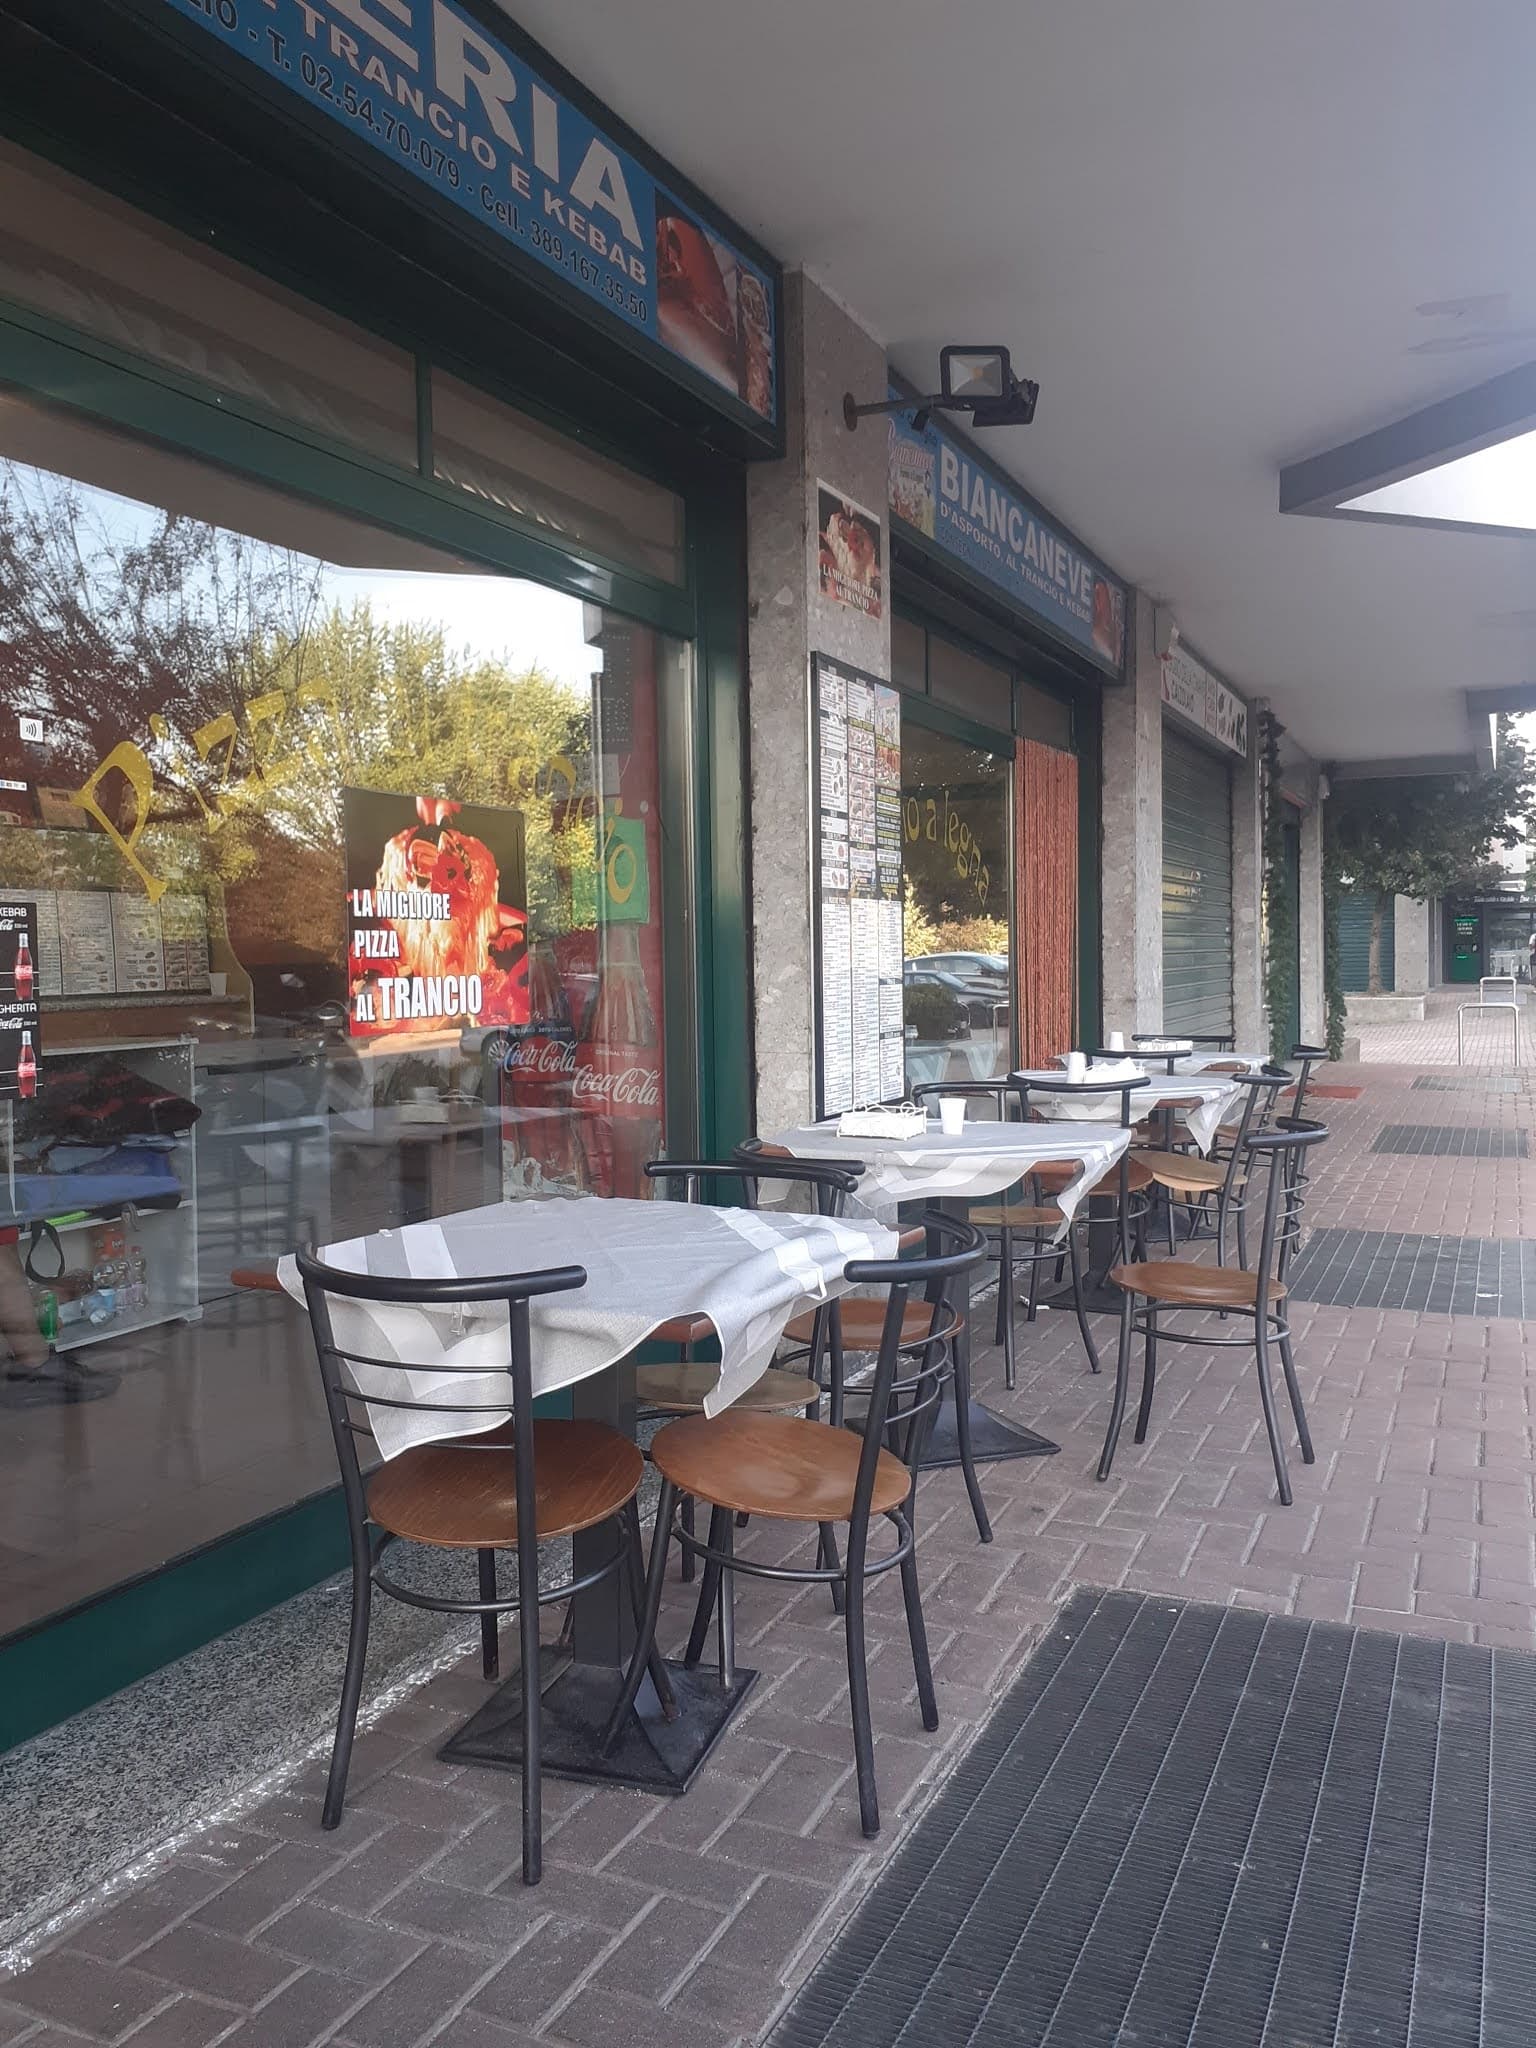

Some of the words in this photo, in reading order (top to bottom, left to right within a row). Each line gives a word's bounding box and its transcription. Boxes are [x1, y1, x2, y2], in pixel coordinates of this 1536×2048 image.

[295, 0, 497, 170] TRANCIO
[510, 162, 532, 200] E
[543, 187, 648, 287] KEBAB
[266, 27, 292, 72] T.
[300, 52, 461, 194] 02.54.70.079
[479, 182, 525, 237] Cell.
[530, 218, 649, 323] 389.167.35.50
[940, 442, 1093, 608] BIANCANEVE
[1005, 553, 1018, 573] AL
[1020, 560, 1058, 600] TRANCIO
[0, 907, 28, 918] KEBAB
[352, 888, 374, 919] LA
[375, 889, 452, 921] MIGLIORE
[353, 929, 400, 959] PIZZA
[355, 993, 377, 1023] AL
[377, 974, 484, 1021] TRANCIO
[503, 1040, 578, 1074] Coca-Cola
[572, 1063, 662, 1106] Coca-Cola
